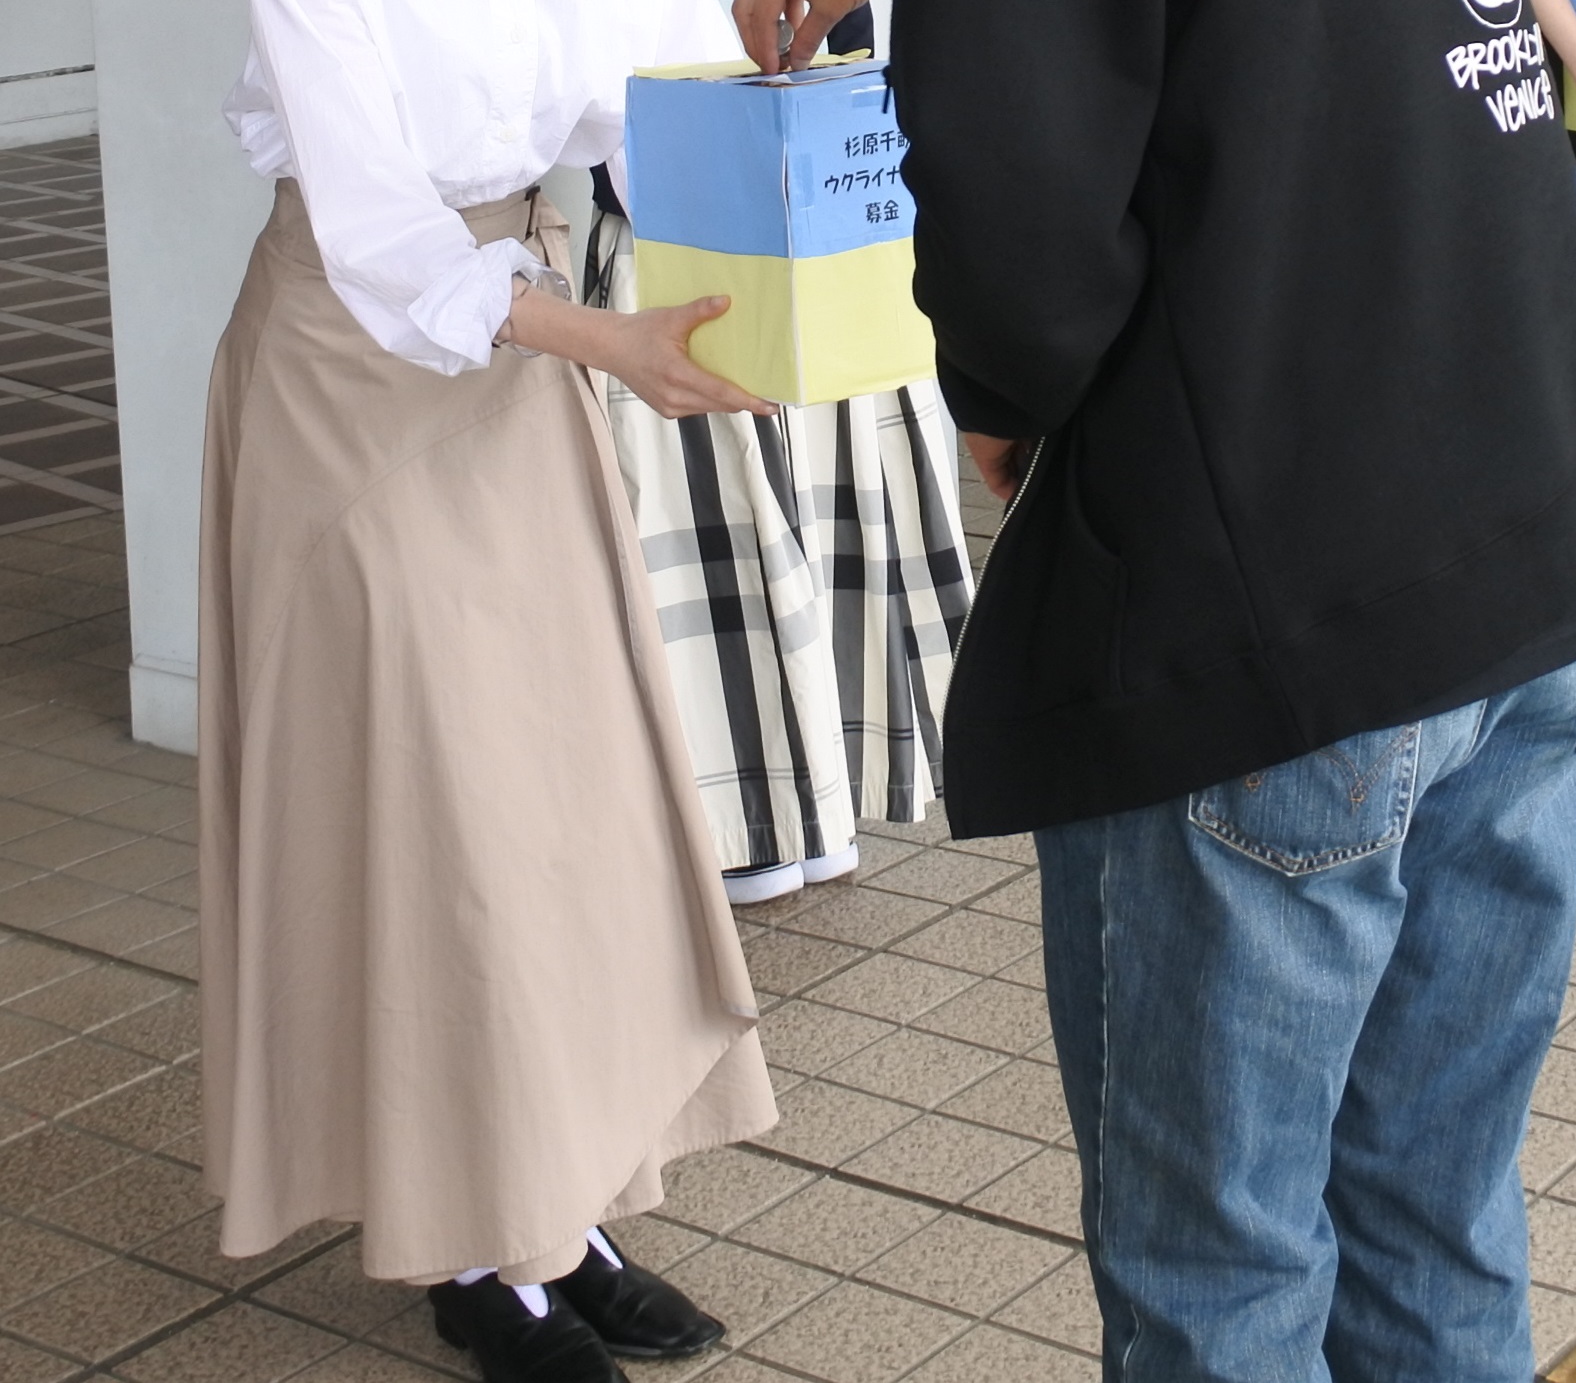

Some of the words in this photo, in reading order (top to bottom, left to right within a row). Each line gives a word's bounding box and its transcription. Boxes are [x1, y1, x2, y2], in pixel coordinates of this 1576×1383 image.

[824, 165, 901, 194] ウクライナ
[865, 199, 900, 224] 募金
